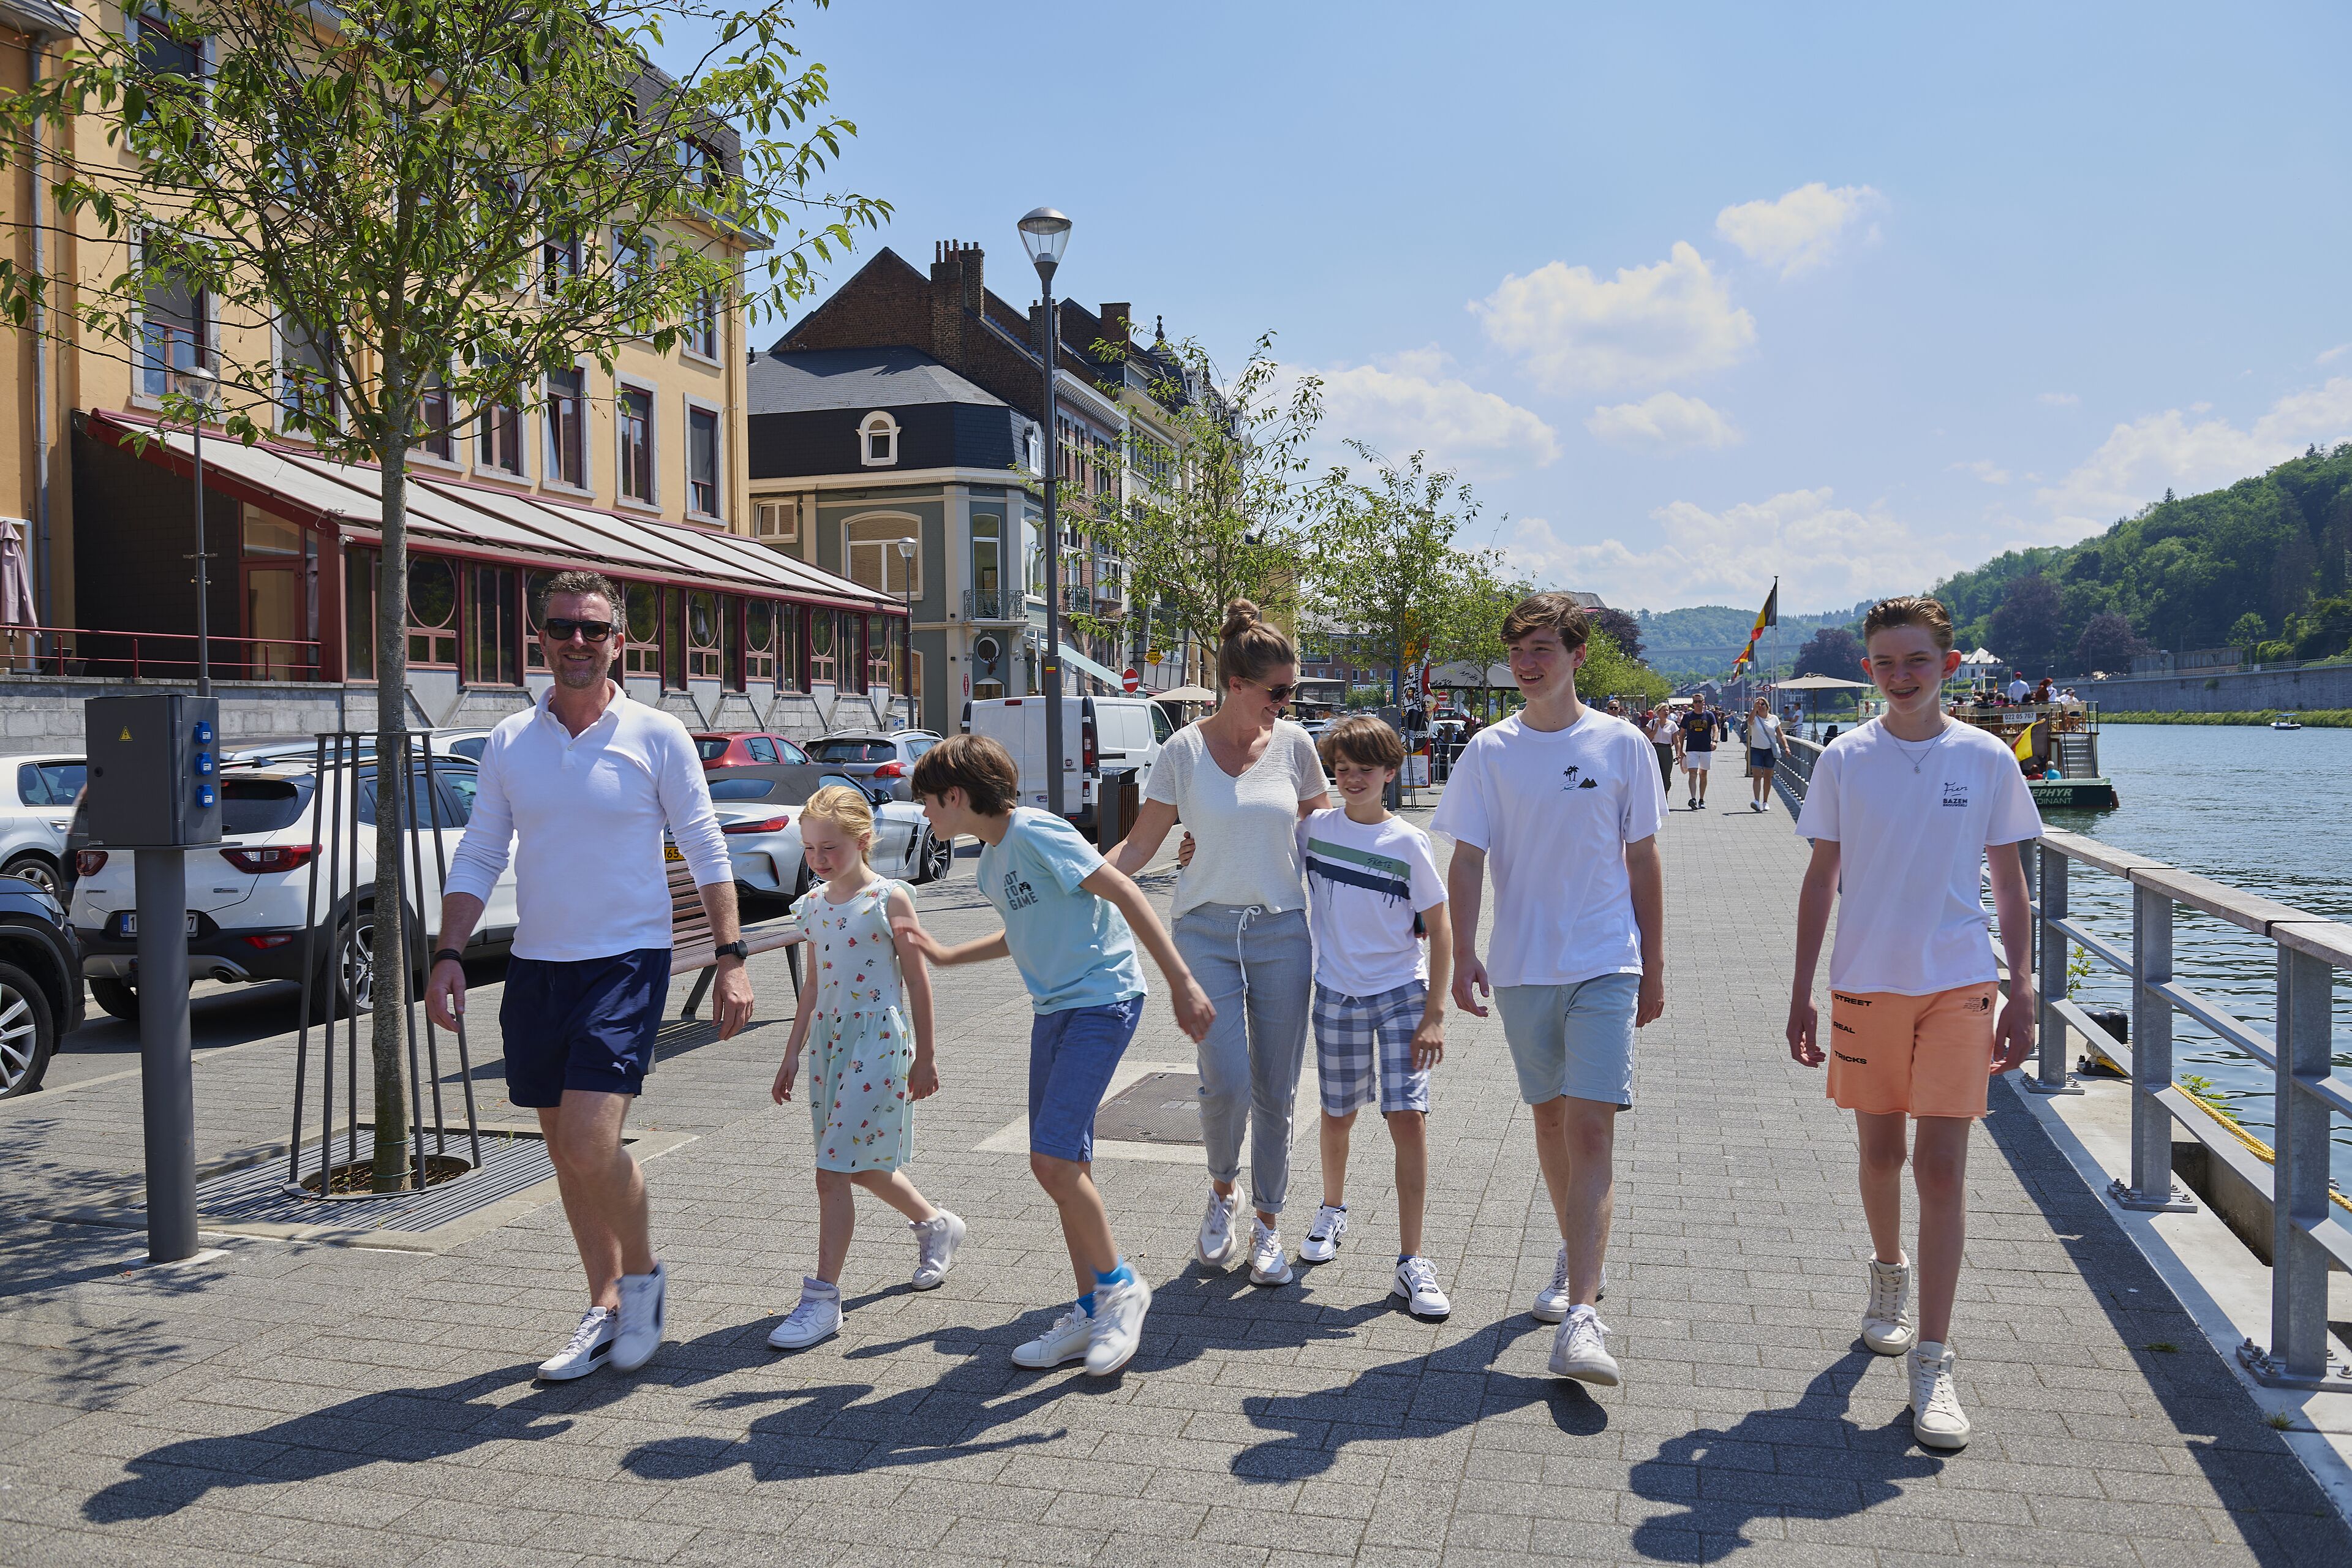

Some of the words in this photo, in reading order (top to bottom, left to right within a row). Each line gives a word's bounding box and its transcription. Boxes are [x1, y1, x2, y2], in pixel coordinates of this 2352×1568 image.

[2030, 788, 2073, 797] EPHYR
[1004, 870, 1018, 888] OT
[1005, 885, 1019, 899] TO
[1009, 891, 1039, 910] GAME
[1834, 993, 1872, 1006] STREET
[1833, 1021, 1855, 1034] REAL
[1834, 1050, 1868, 1065] TRICKS
